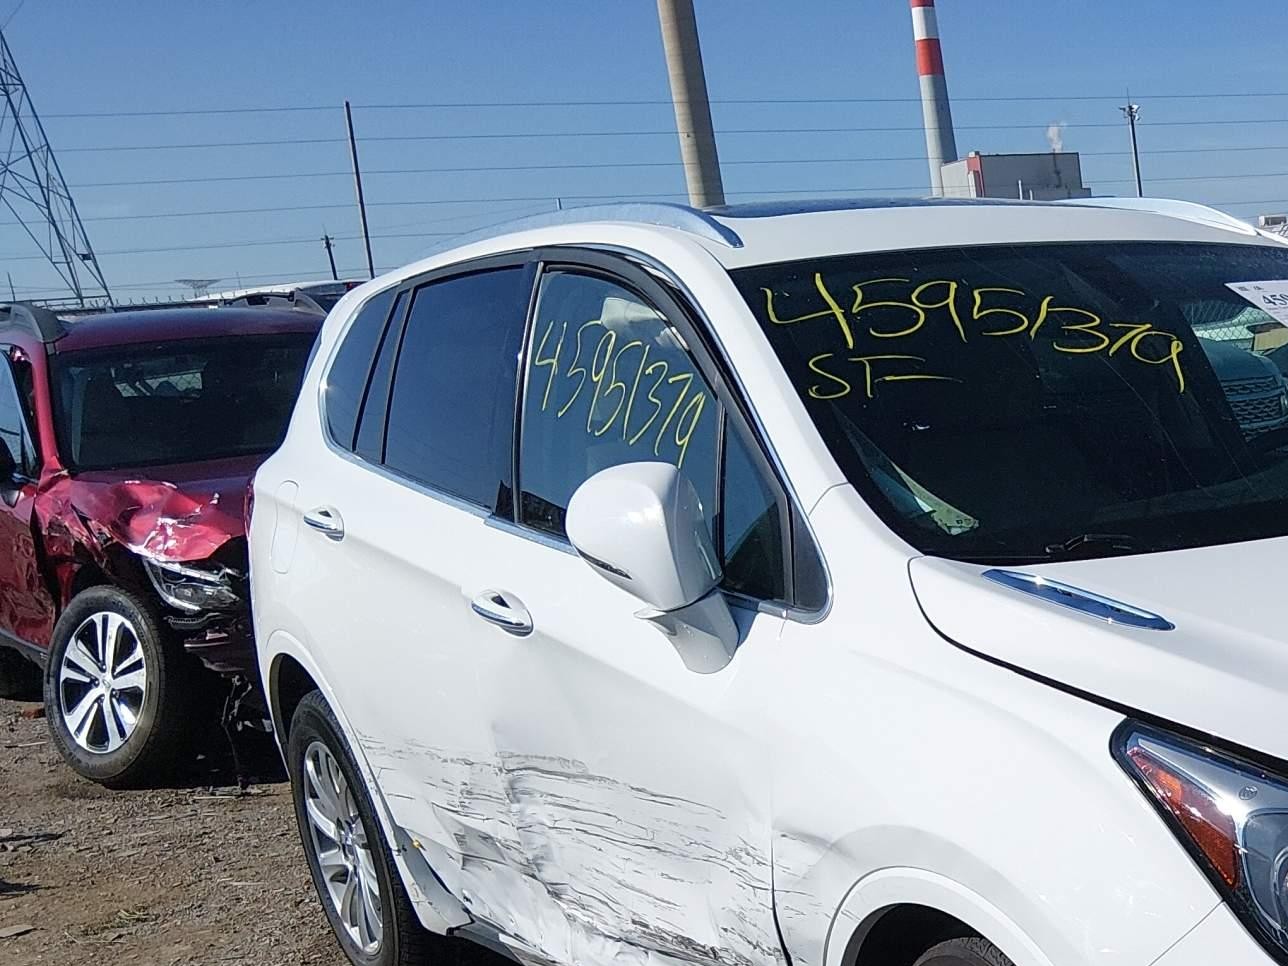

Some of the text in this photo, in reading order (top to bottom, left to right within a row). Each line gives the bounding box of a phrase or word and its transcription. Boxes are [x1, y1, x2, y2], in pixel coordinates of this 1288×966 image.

[760, 272, 1185, 393] 45951379
[807, 352, 964, 399] SF
[534, 319, 706, 469] 45951379
